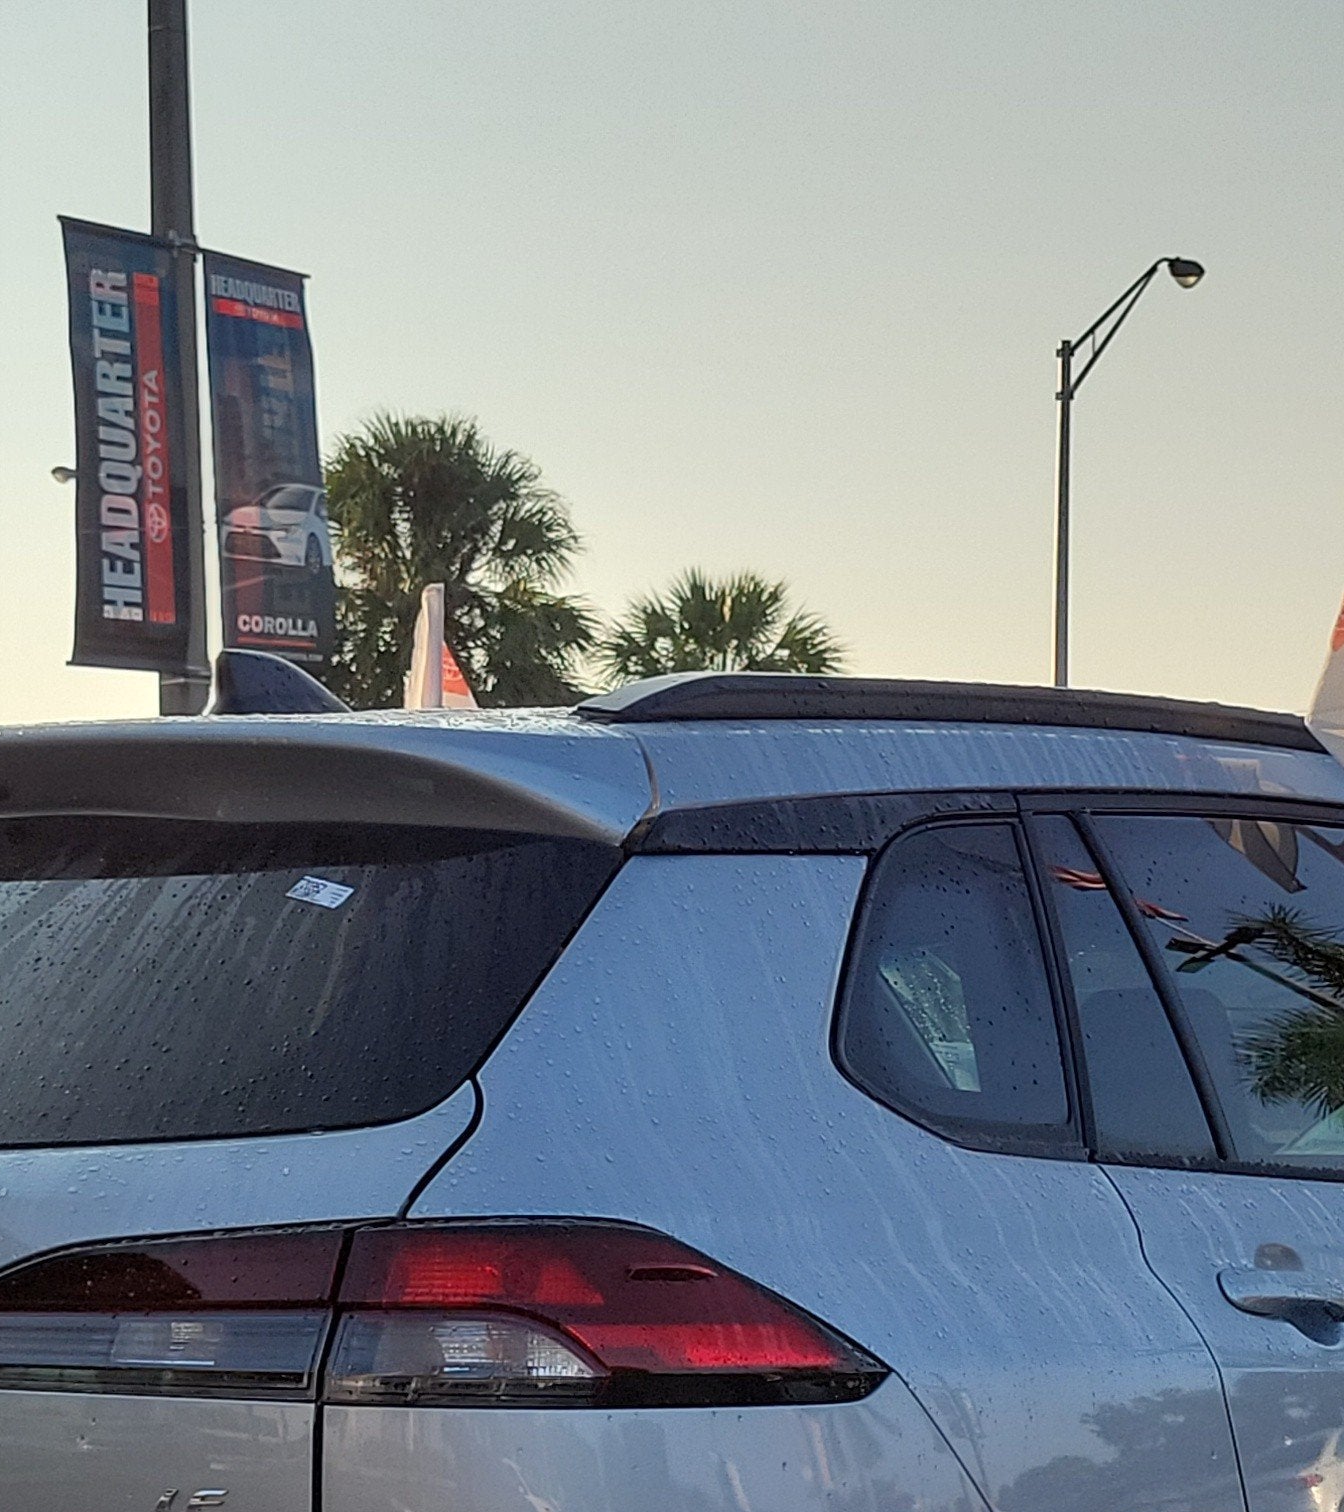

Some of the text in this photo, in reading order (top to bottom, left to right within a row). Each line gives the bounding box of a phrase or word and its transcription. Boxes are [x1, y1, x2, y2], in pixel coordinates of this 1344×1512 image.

[211, 274, 301, 313] HEADQUARTER
[90, 268, 143, 621] HEADQUARTER
[141, 369, 164, 494] TOYOTA
[237, 614, 319, 637] COROLLA
